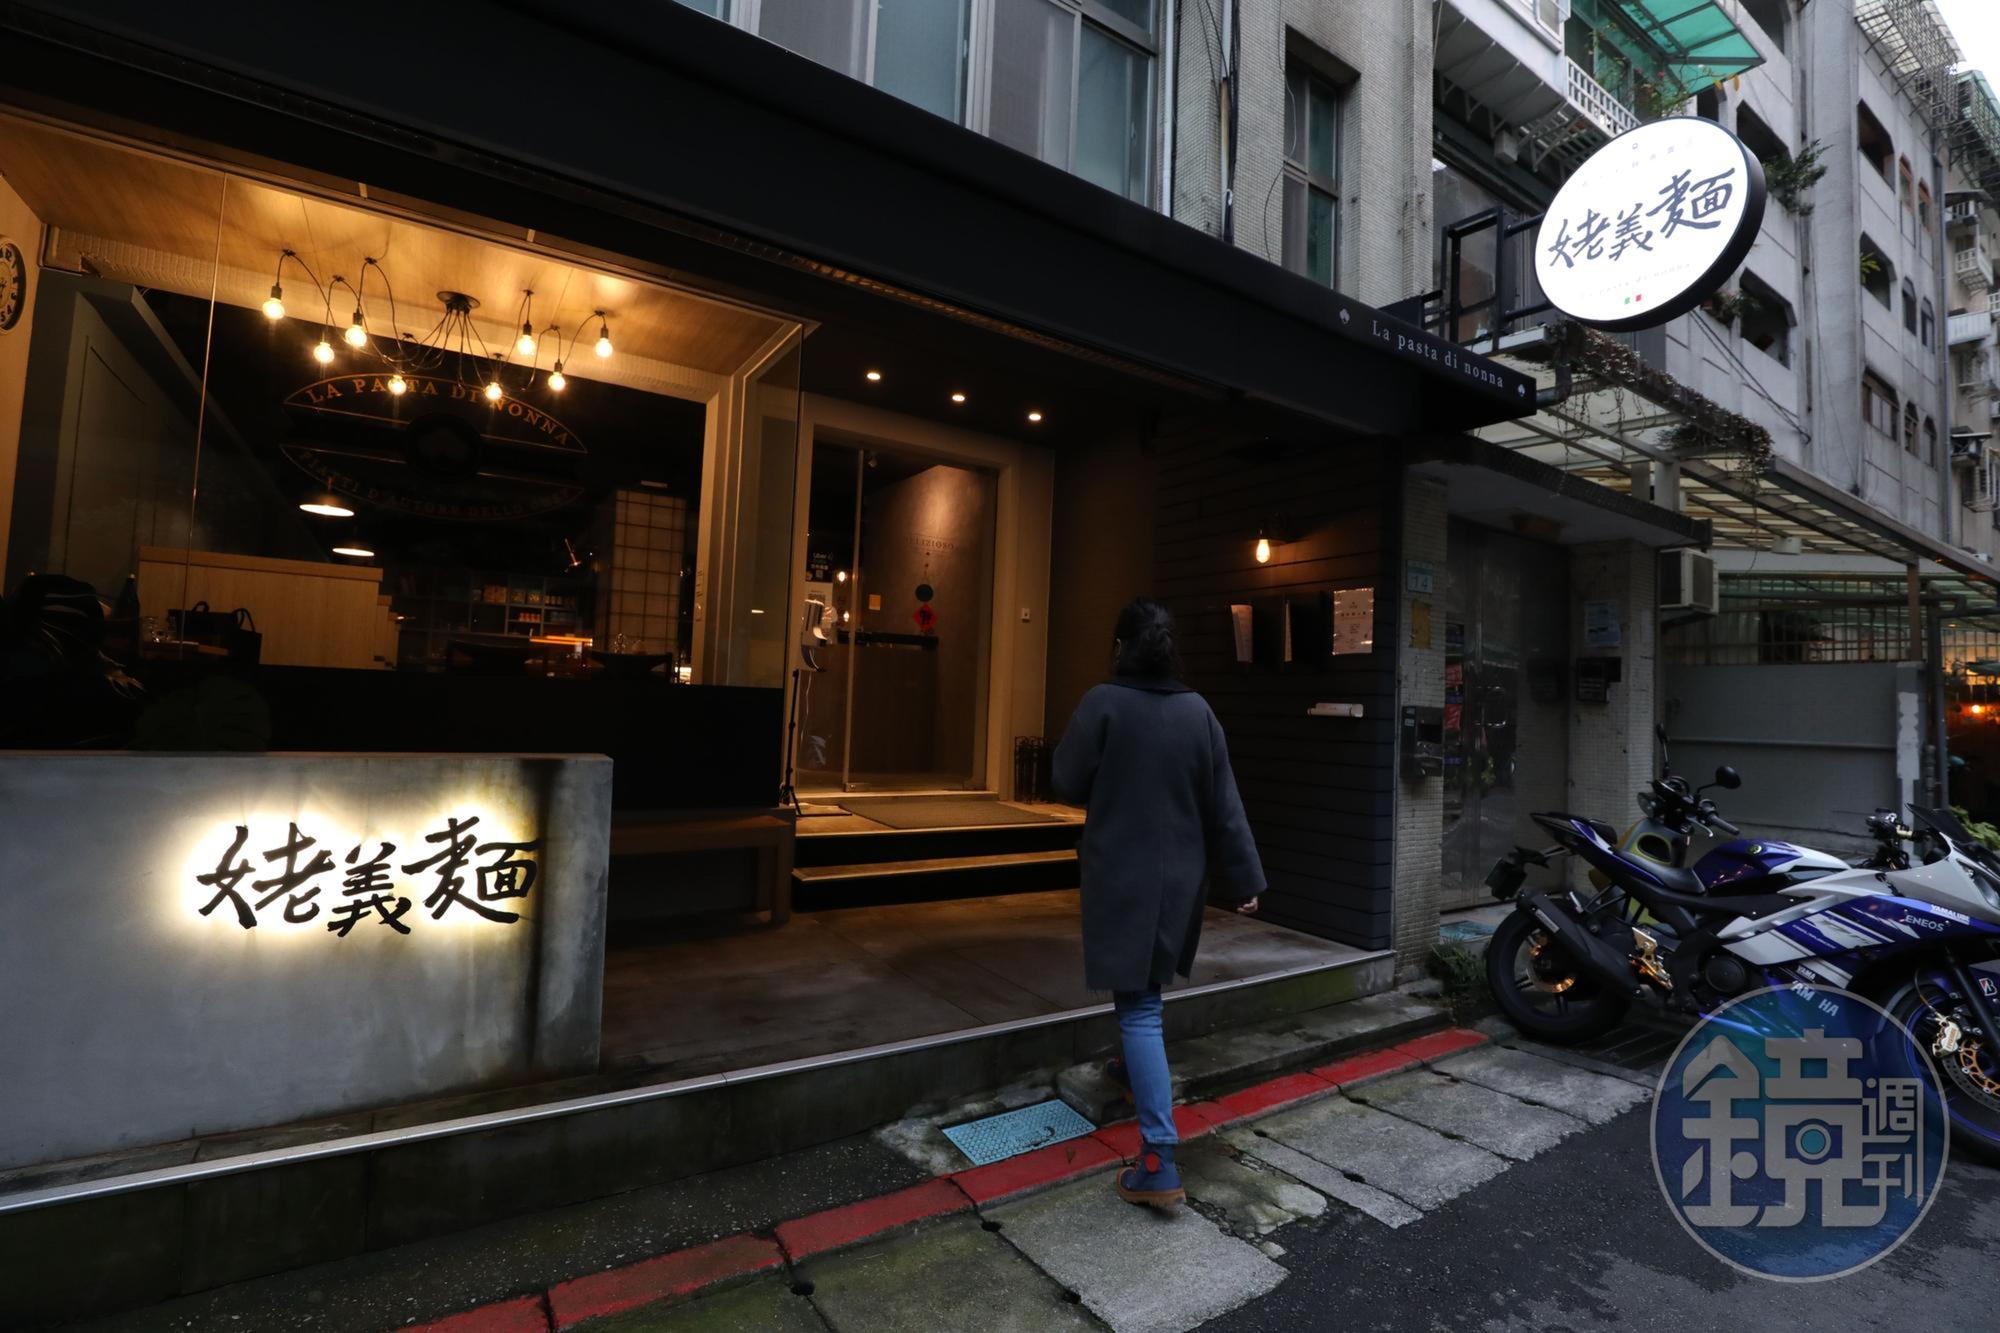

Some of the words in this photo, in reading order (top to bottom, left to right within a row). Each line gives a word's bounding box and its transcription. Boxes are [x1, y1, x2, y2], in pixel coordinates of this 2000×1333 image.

[1548, 168, 1736, 269] 姥義麵
[1372, 319, 1390, 341] La
[1398, 334, 1438, 361] pasta
[1444, 351, 1458, 369] di
[1464, 362, 1504, 388] nonna
[305, 383, 343, 404] LA
[352, 377, 439, 396] PATA
[450, 384, 480, 403] DI
[197, 816, 545, 937] 姥義麵
[1905, 914, 1945, 933] ENEOS
